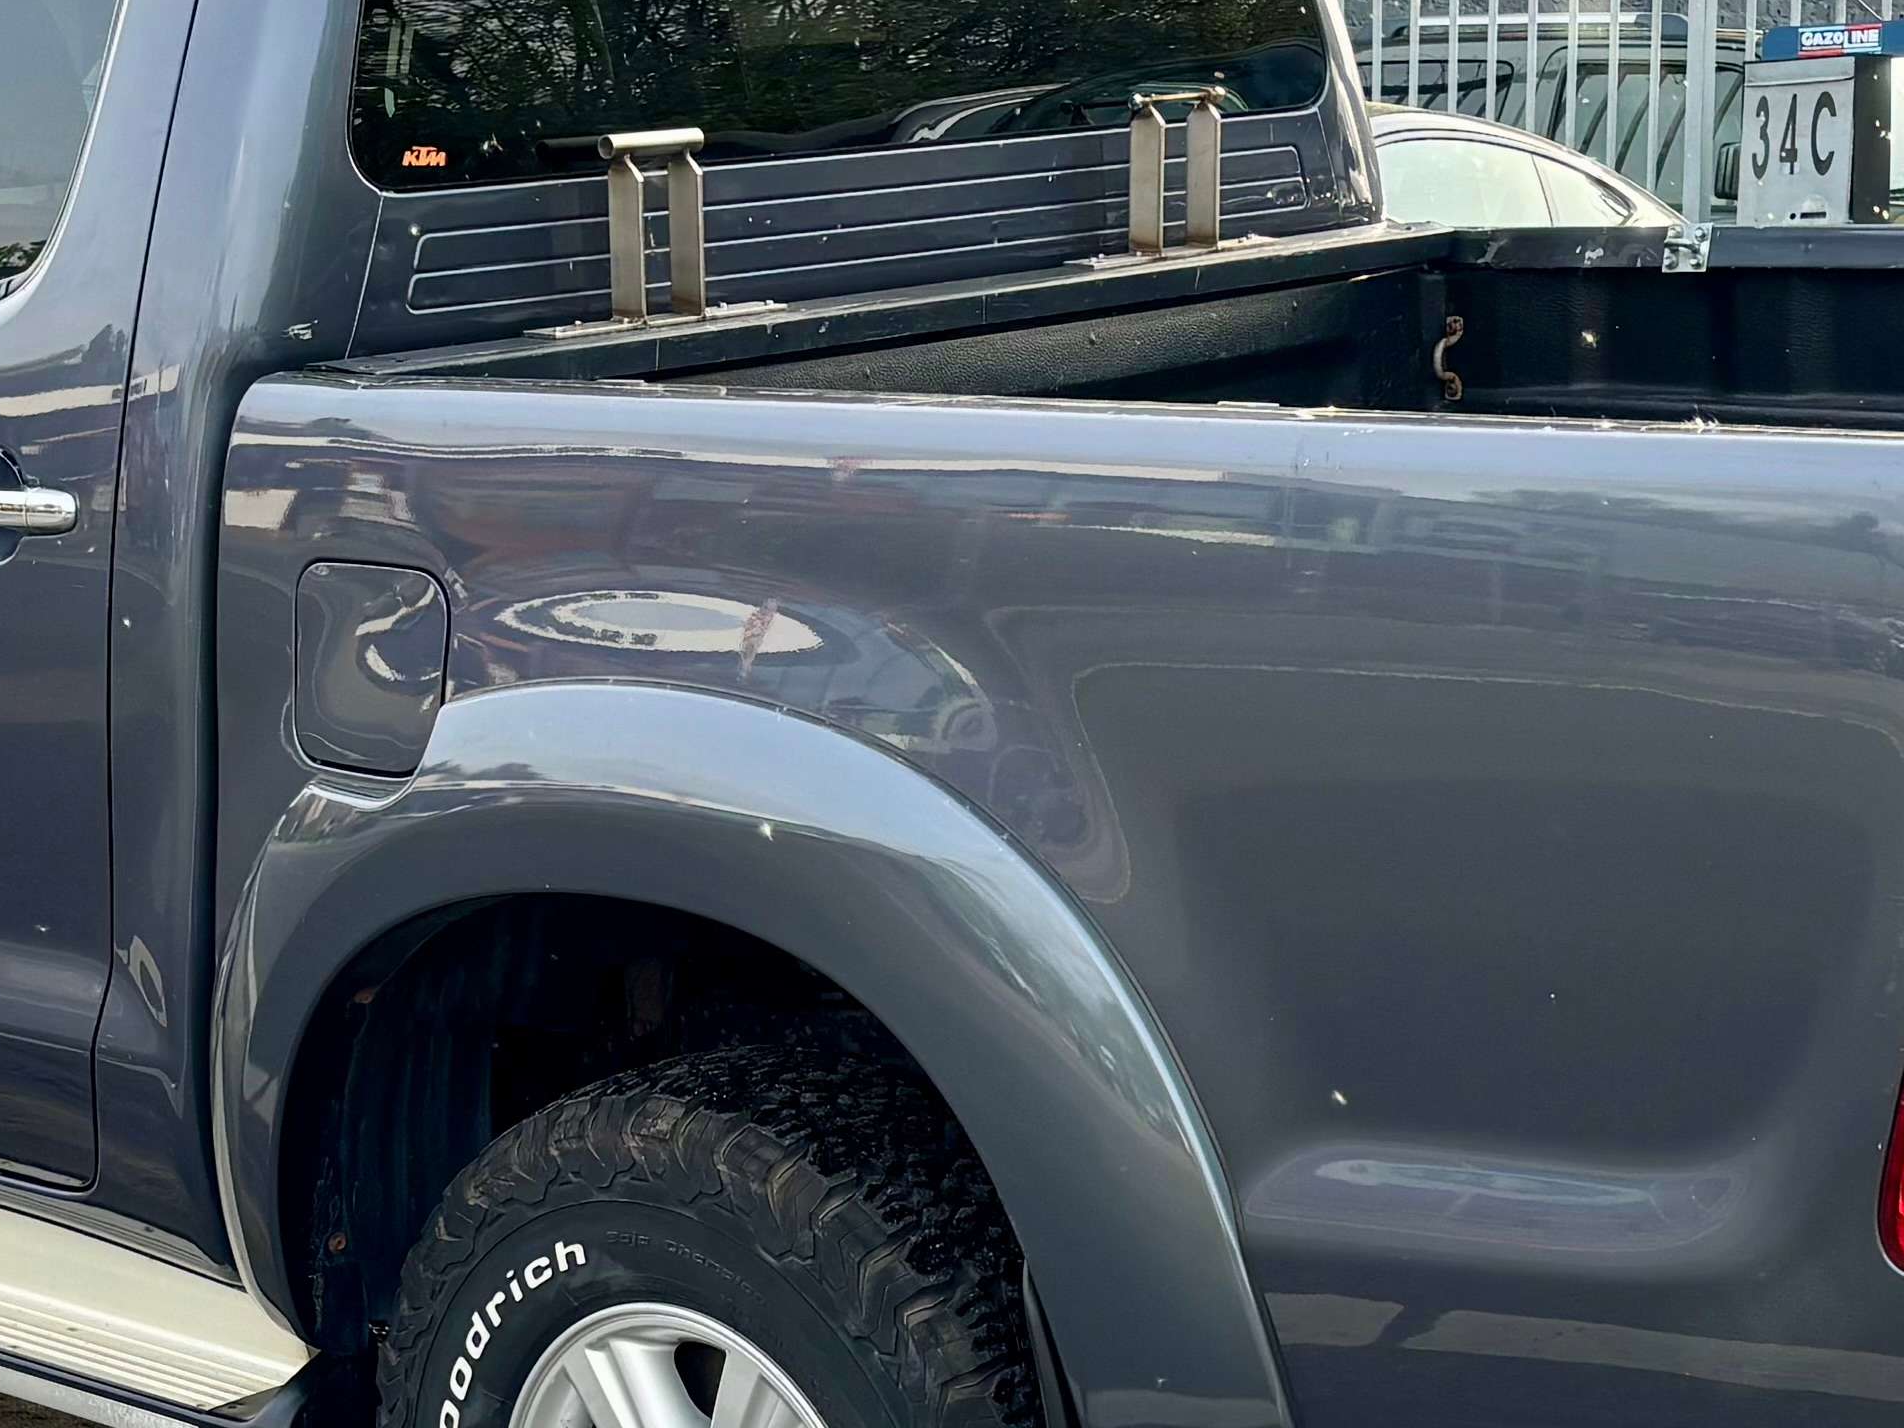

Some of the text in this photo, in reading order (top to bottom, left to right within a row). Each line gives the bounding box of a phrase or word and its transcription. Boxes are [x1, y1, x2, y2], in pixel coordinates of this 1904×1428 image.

[1801, 29, 1879, 47] GAZOLINE
[1751, 90, 1837, 180] 34C
[402, 146, 446, 167] KTM
